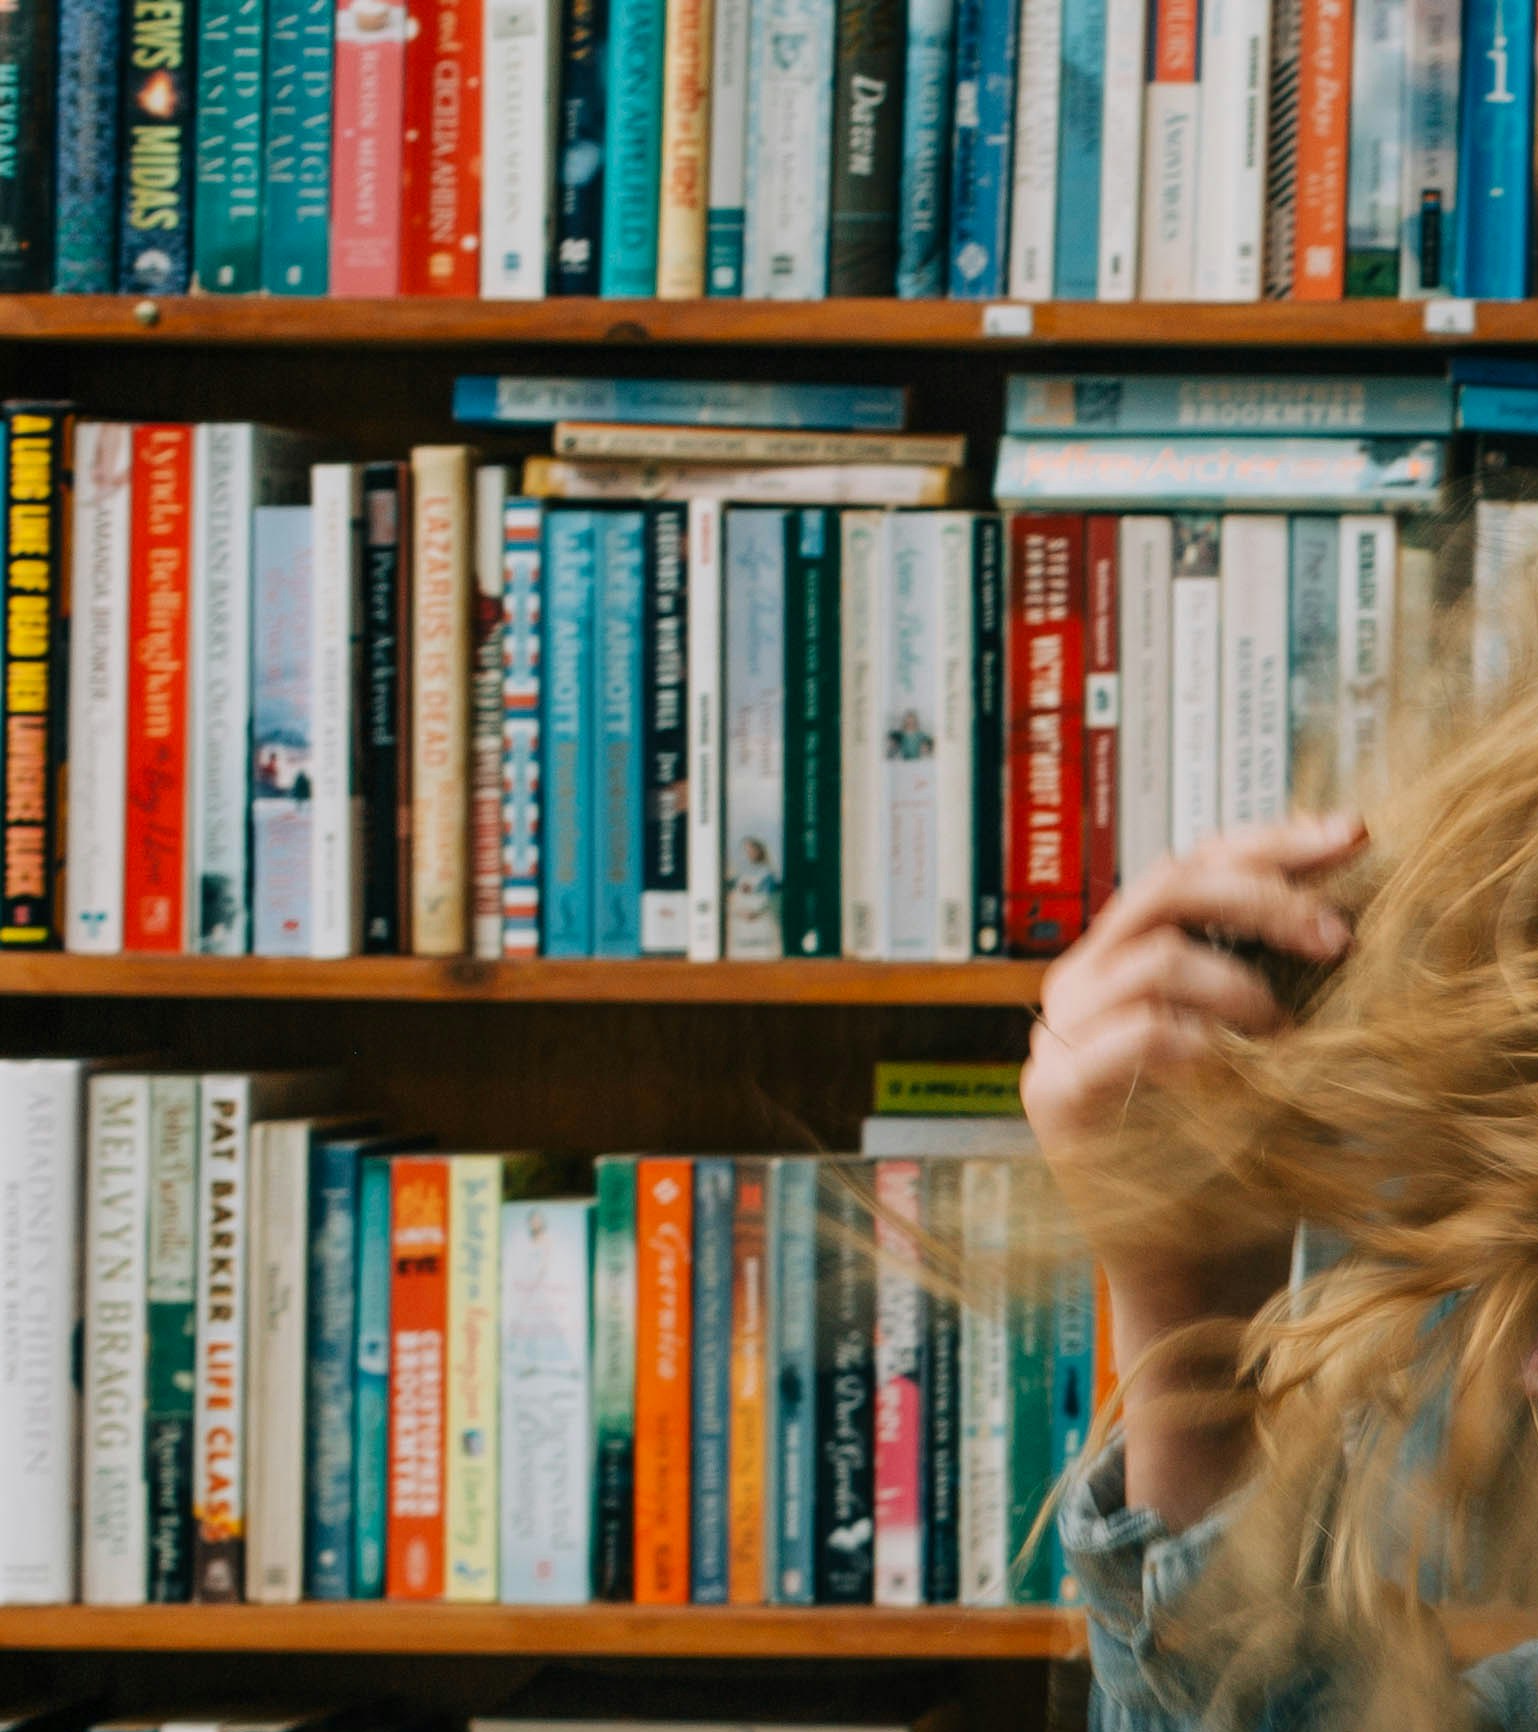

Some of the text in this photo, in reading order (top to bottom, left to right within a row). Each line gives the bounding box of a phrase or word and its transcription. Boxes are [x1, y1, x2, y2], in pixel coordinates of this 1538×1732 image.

[130, 125, 178, 229] MIDAS
[428, 61, 459, 243] CECELIA AHERN
[1162, 109, 1188, 243] ANONYMOUS
[10, 439, 53, 499] LONG
[9, 504, 50, 555] LINE
[9, 559, 49, 592] OF
[88, 503, 113, 601] AMANDA
[1046, 536, 1068, 623] STEFAN
[7, 596, 50, 656] DEAD
[139, 429, 185, 739] Lynda Bellingham
[369, 551, 395, 622] Peter
[421, 495, 447, 769] LAZARUS IS DEAD
[6, 662, 50, 711] MEN
[554, 622, 579, 736] ARNOTT
[604, 622, 631, 736] ARNOTT
[1028, 634, 1064, 710] VICTIM
[1028, 713, 1064, 808] WITHOUT
[1026, 828, 1062, 884] FACE
[93, 1093, 135, 1451] MELVYN BRAGG
[203, 1098, 236, 1542] PAT BARKER LIFE CLASS
[647, 1221, 686, 1381] Guernica
[393, 1330, 418, 1518] BROOKMYRE
[418, 1329, 441, 1518] CHRISTOPHER
